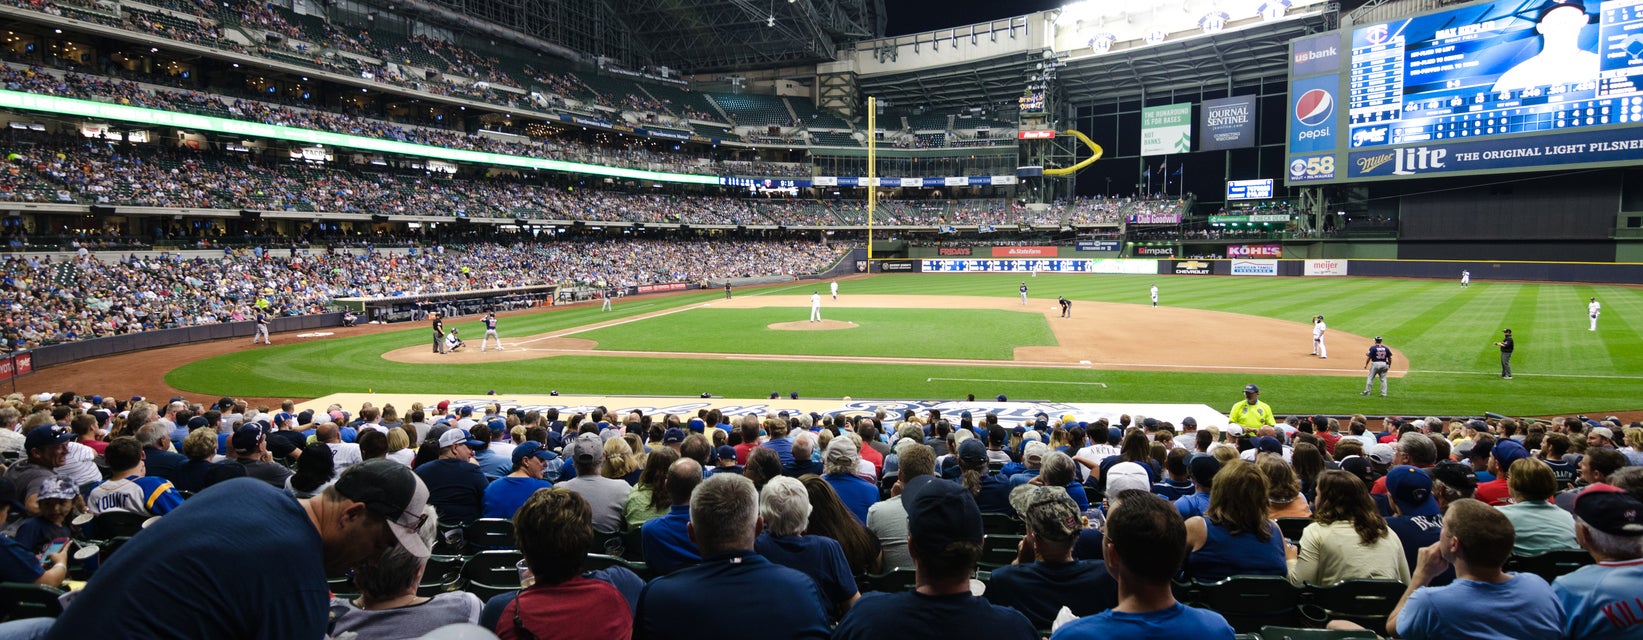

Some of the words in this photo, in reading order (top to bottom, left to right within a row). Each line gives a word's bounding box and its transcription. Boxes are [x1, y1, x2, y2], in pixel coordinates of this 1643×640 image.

[1155, 107, 1188, 116] RUNAROUND
[1208, 107, 1249, 119] JOURNAL
[1207, 115, 1248, 127] SENTINEL
[1299, 127, 1330, 141] pepsi
[1357, 153, 1394, 174] Miller
[1392, 147, 1447, 175] Lite
[1456, 151, 1479, 162] THE
[1482, 147, 1541, 160] ORIGINAL
[1545, 143, 1586, 156] LIGHT
[1306, 156, 1334, 176] 58
[1138, 215, 1150, 224] Club
[1152, 214, 1177, 224] Goodwill
[1145, 247, 1173, 256] impact
[1314, 261, 1338, 270] meijer
[95, 492, 129, 512] YOUNT
